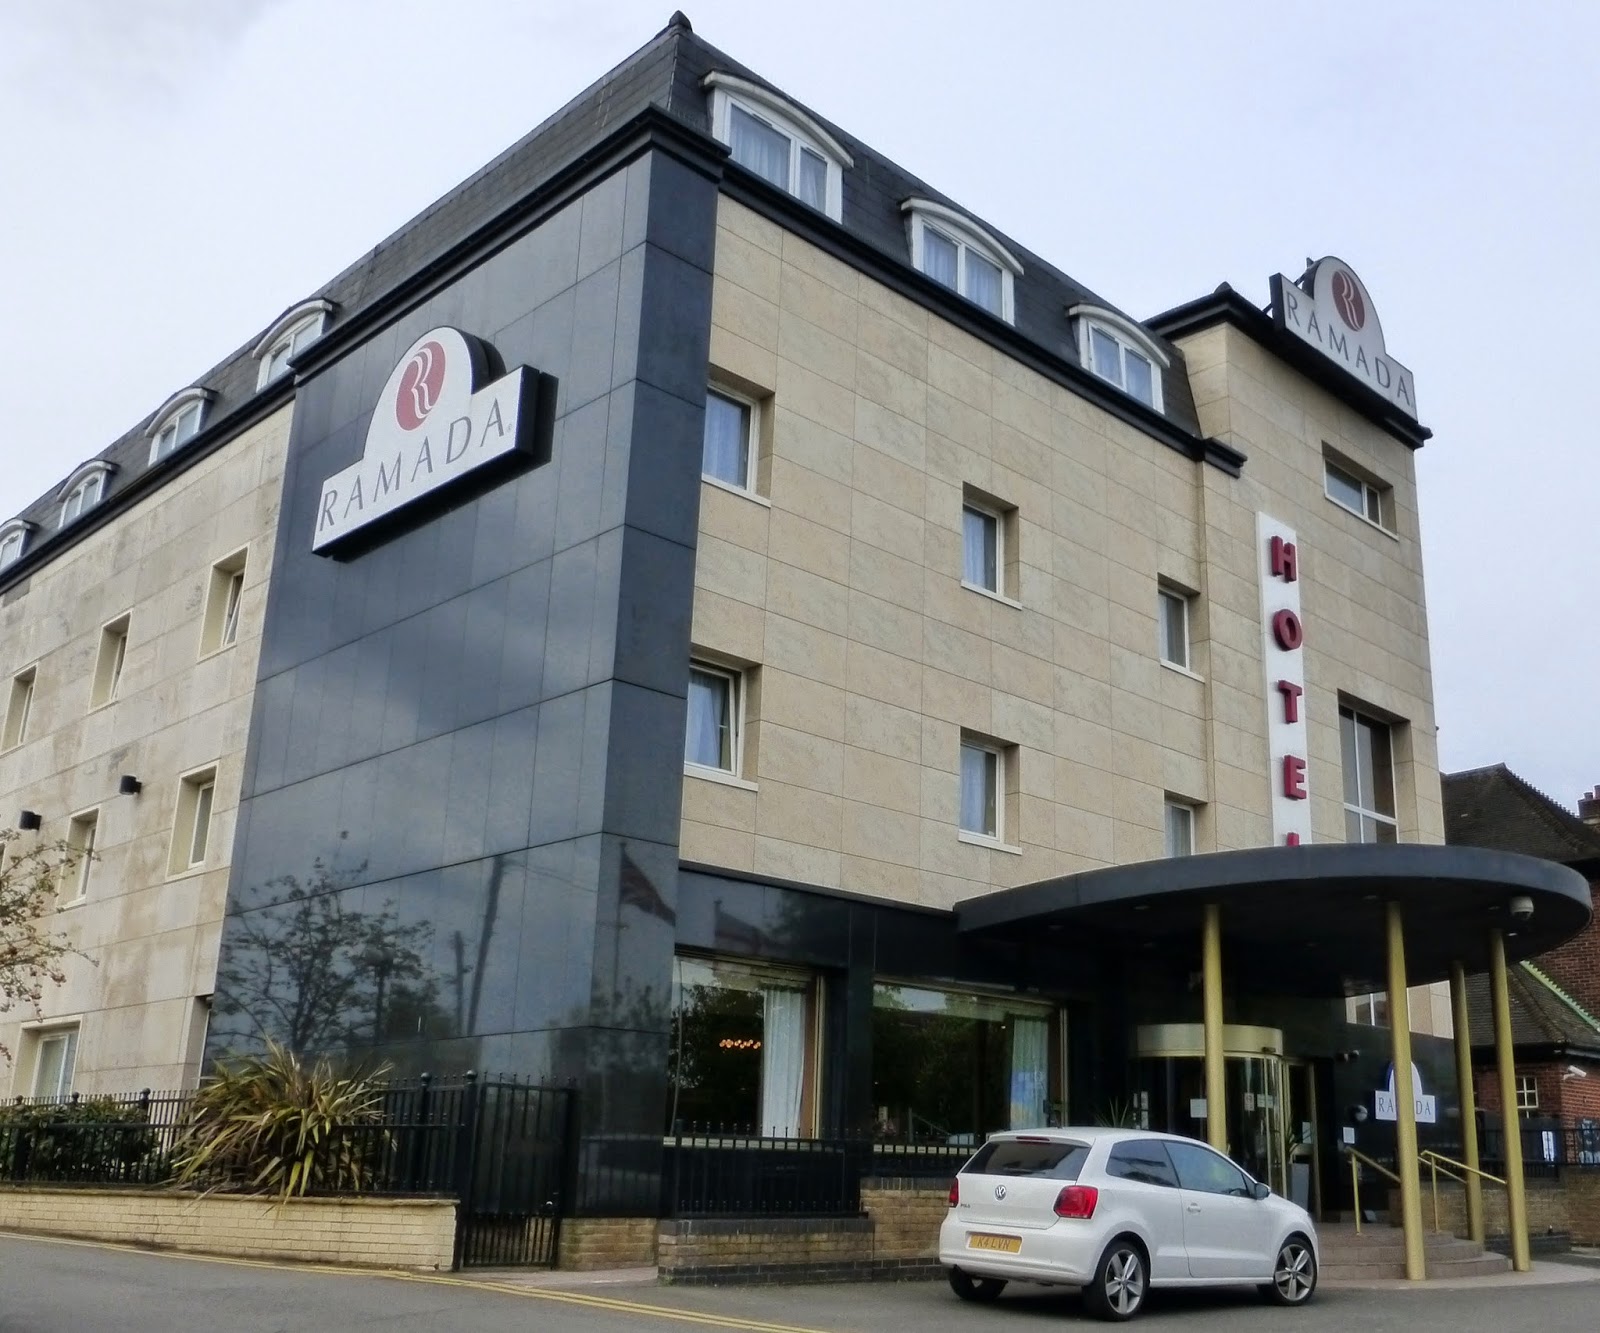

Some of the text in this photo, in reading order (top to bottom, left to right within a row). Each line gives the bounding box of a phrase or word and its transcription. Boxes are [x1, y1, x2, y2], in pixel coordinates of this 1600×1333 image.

[1286, 290, 1411, 406] RAMADA
[319, 397, 505, 532] RAMADA
[1378, 1097, 1431, 1116] RADA
